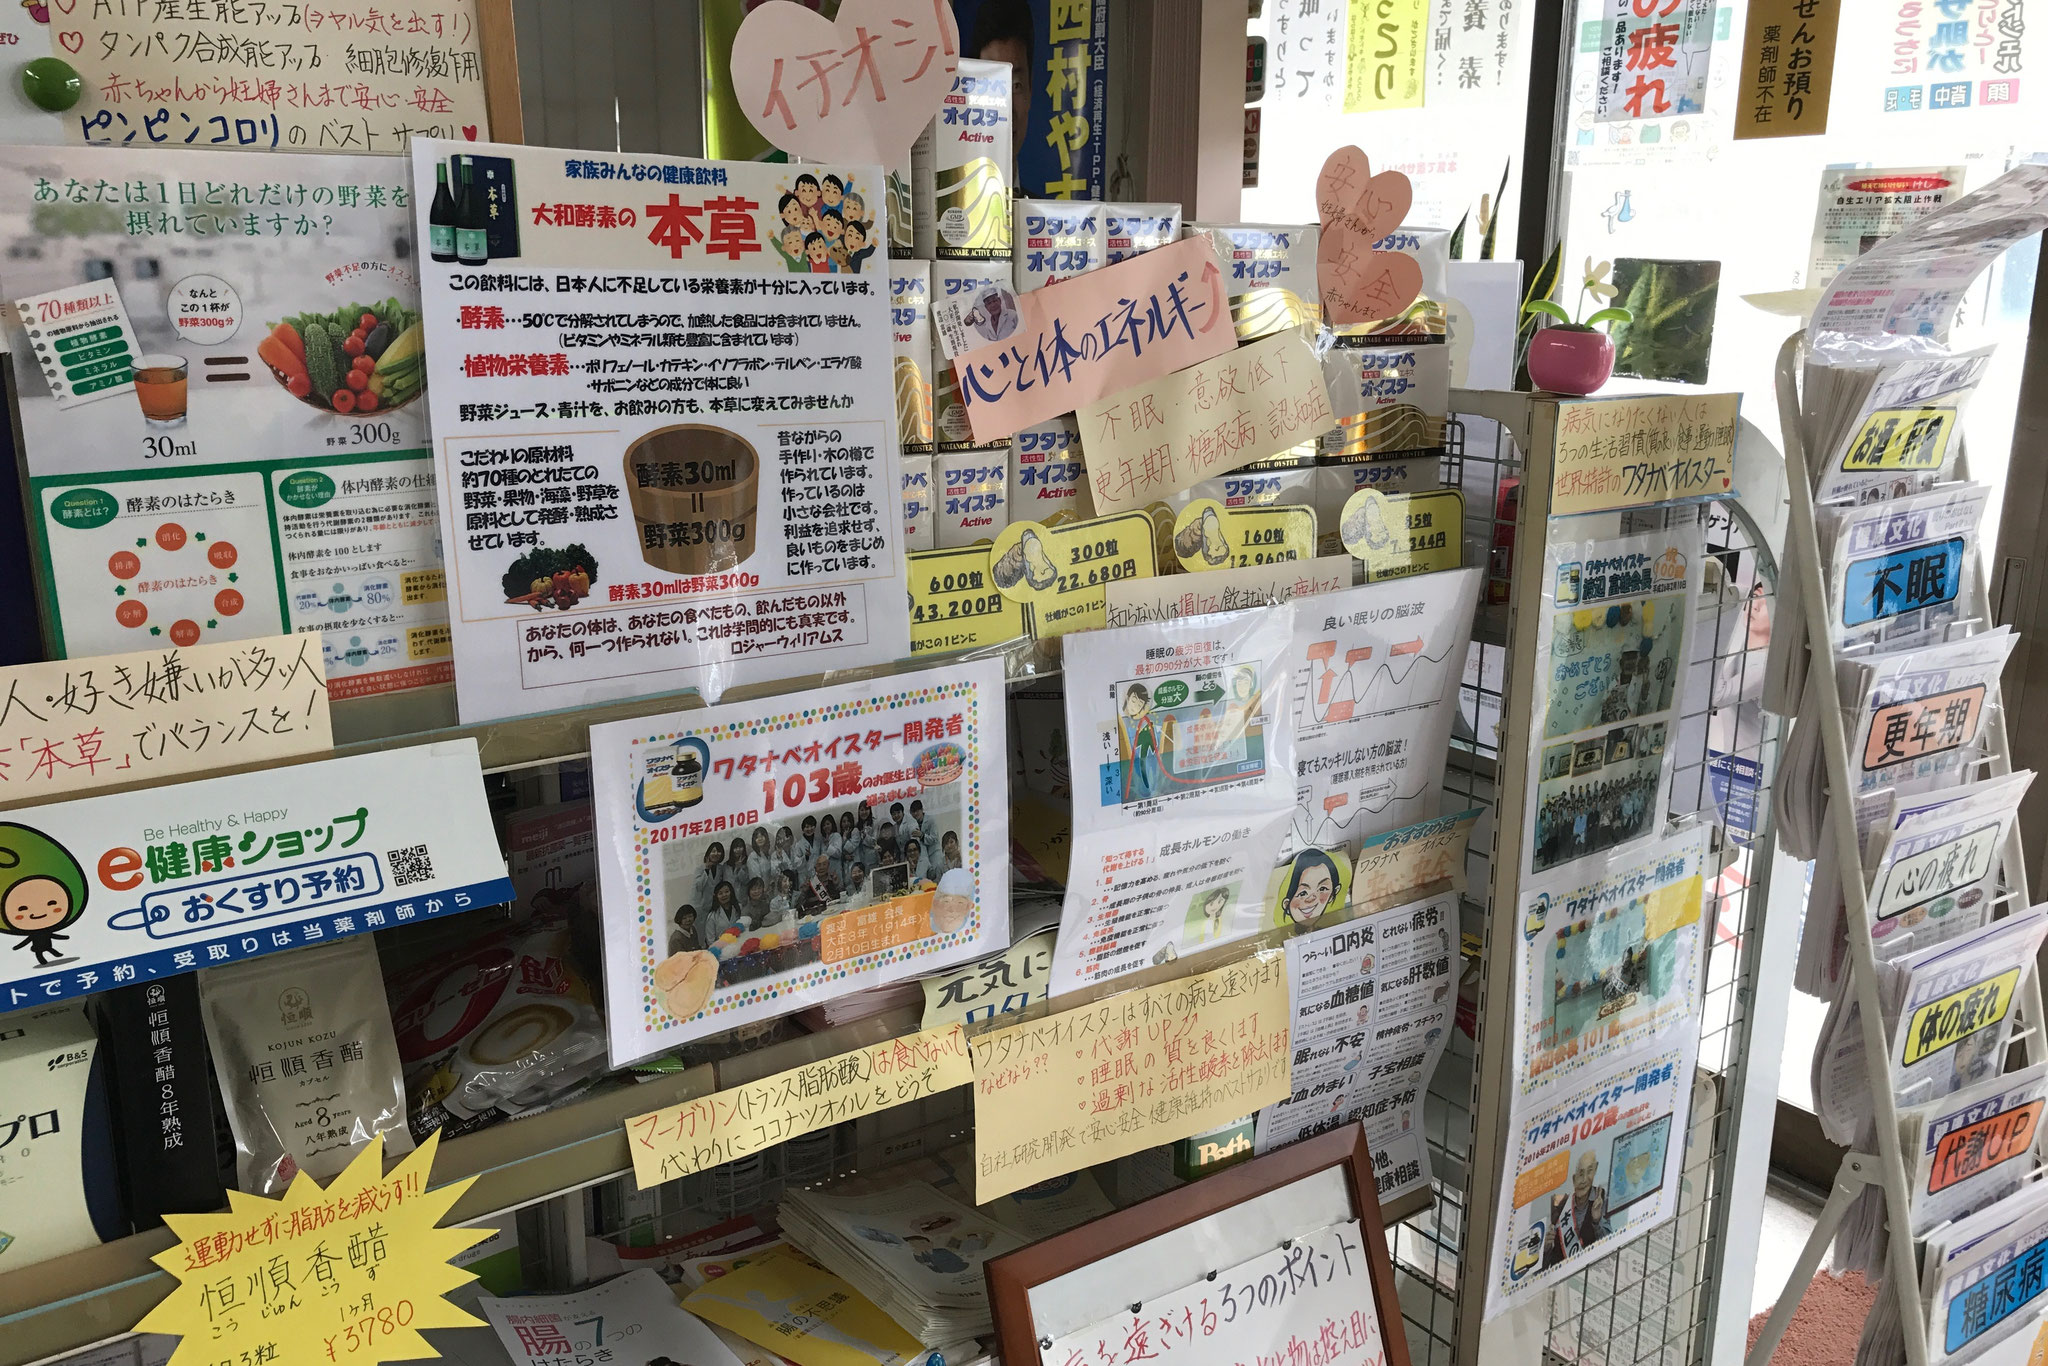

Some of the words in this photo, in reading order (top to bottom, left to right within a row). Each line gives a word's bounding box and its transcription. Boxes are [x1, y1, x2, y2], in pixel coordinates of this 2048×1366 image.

[345, 43, 480, 84] 細胞修復作用
[1753, 25, 1781, 123] 薬剤師不在
[942, 107, 1008, 126] オイスター
[564, 158, 728, 187] 家族みんなの健康飲料
[34, 176, 409, 208] あなたは1日どれだけの野菜を
[126, 213, 334, 238] 摂れていますか?
[531, 202, 637, 230] 大和酵素の
[645, 193, 762, 261] 本草
[1025, 216, 1098, 236] ワタナベ
[938, 248, 969, 257] WATANABE
[970, 248, 990, 257] ACTIVE
[992, 248, 1012, 257] OYSTER
[448, 273, 876, 297] この飲料には、日本人に不足している栄養素が十分に入っています。
[1326, 241, 1400, 309] 安全
[189, 288, 218, 299] なんと
[1325, 287, 1381, 320] 赤ちゃんまで
[37, 293, 114, 323] 70種類以上
[178, 316, 235, 329] 野菜300g分
[962, 267, 1207, 407] 心と体のエネルギー
[78, 347, 112, 361] ビタミン
[85, 361, 118, 375] ミネラル
[142, 434, 197, 460] 30ml
[326, 435, 348, 447] 野菜
[350, 421, 401, 449] 300g
[777, 429, 842, 445] 昔ながらの
[940, 441, 970, 451] WATANABE
[460, 445, 574, 466] こだわりの原材料
[778, 445, 875, 465] 手作り・木の樽で
[1020, 453, 1045, 464] 活性型
[1273, 459, 1298, 468] OYSTER
[461, 464, 599, 489] 約70種のとれたての
[636, 458, 736, 488] 酵素30ml
[780, 465, 874, 484] 作られています。
[945, 465, 1004, 486] ワタナベ
[63, 498, 94, 507] Question
[126, 489, 236, 514] 酵素のはたらき
[463, 484, 620, 509] 野菜・果物・海藻・野草を
[781, 484, 865, 501] 作っているのは
[945, 493, 1005, 515] オイスター
[946, 486, 967, 496] 活性型
[1036, 486, 1077, 500] Active
[62, 506, 109, 519] 酵素とは?
[466, 503, 619, 531] 原料として発酵・熟成さ
[782, 501, 880, 521] 小さな会社です。
[959, 516, 993, 528] Active
[467, 529, 548, 551] せています。
[643, 518, 746, 550] 野菜300g
[784, 521, 884, 539] 利益を追求せず、
[1243, 528, 1284, 545] 160粒
[786, 536, 886, 558] 良いものをまじめ
[1070, 538, 1119, 563] 300粒
[787, 556, 879, 577] に作っています。
[1057, 559, 1137, 593] 22,680円
[138, 574, 218, 594] 酵素のはたらき
[608, 573, 760, 602] 酵素30mlは野菜300g
[929, 571, 984, 593] 600粒
[1861, 551, 1948, 617] 不眠
[525, 591, 847, 641] あなたの体は、あなたの食べたもの、飲んだもの以外
[912, 593, 1003, 621] 43,200円
[1322, 601, 1426, 632] 良い眠りの脳波
[526, 610, 858, 663] から、何一つ作られない。これは学問的にも真実です。
[731, 627, 844, 656] ロジャーウィリアムス
[1877, 697, 1972, 764] 更年期
[712, 713, 964, 780] ワタナベオイスター開発者
[1297, 738, 1409, 777] 寝てもスッキリしない方の脳波!
[143, 827, 164, 841] Be
[168, 817, 222, 839] Healthy
[226, 814, 239, 828] &
[242, 807, 289, 827] Happy
[650, 809, 759, 845] 2017年2月10日
[1382, 816, 1459, 852] おすすめ品
[1159, 827, 1252, 858] 成長ホルモンの働き
[1360, 850, 1401, 874] ワタナベ
[1418, 832, 1462, 854] オイスター
[184, 864, 365, 925] おくすり予約
[1565, 858, 1686, 918] ワタナベオイスター開発者
[1380, 956, 1450, 994] 気になる肝数値
[976, 956, 1283, 1068] ワタナベオイスターはすべての病を遠ざけます
[1299, 979, 1375, 1018] 気になる血糖値
[1916, 982, 2001, 1058] 体の疲れ
[268, 1038, 304, 1052] KOJUN
[308, 1030, 337, 1044] KOZU
[1293, 1031, 1366, 1067] 眠れない不安
[66, 1049, 88, 1062] B&S
[1367, 1052, 1427, 1081] 子宝相談
[299, 1075, 330, 1088] カプセル
[1527, 1061, 1674, 1145] ワタナベオイスター開発者
[294, 1118, 313, 1129] Aged
[315, 1106, 331, 1128] 8
[332, 1108, 352, 1119] years
[304, 1125, 349, 1146] 八年熟成
[1941, 1110, 2031, 1183] 代謝UP
[1523, 1133, 1570, 1166] 2016年2月10日
[1960, 1247, 2047, 1339] 糖尿病
[323, 1299, 415, 1363] ¥3780
